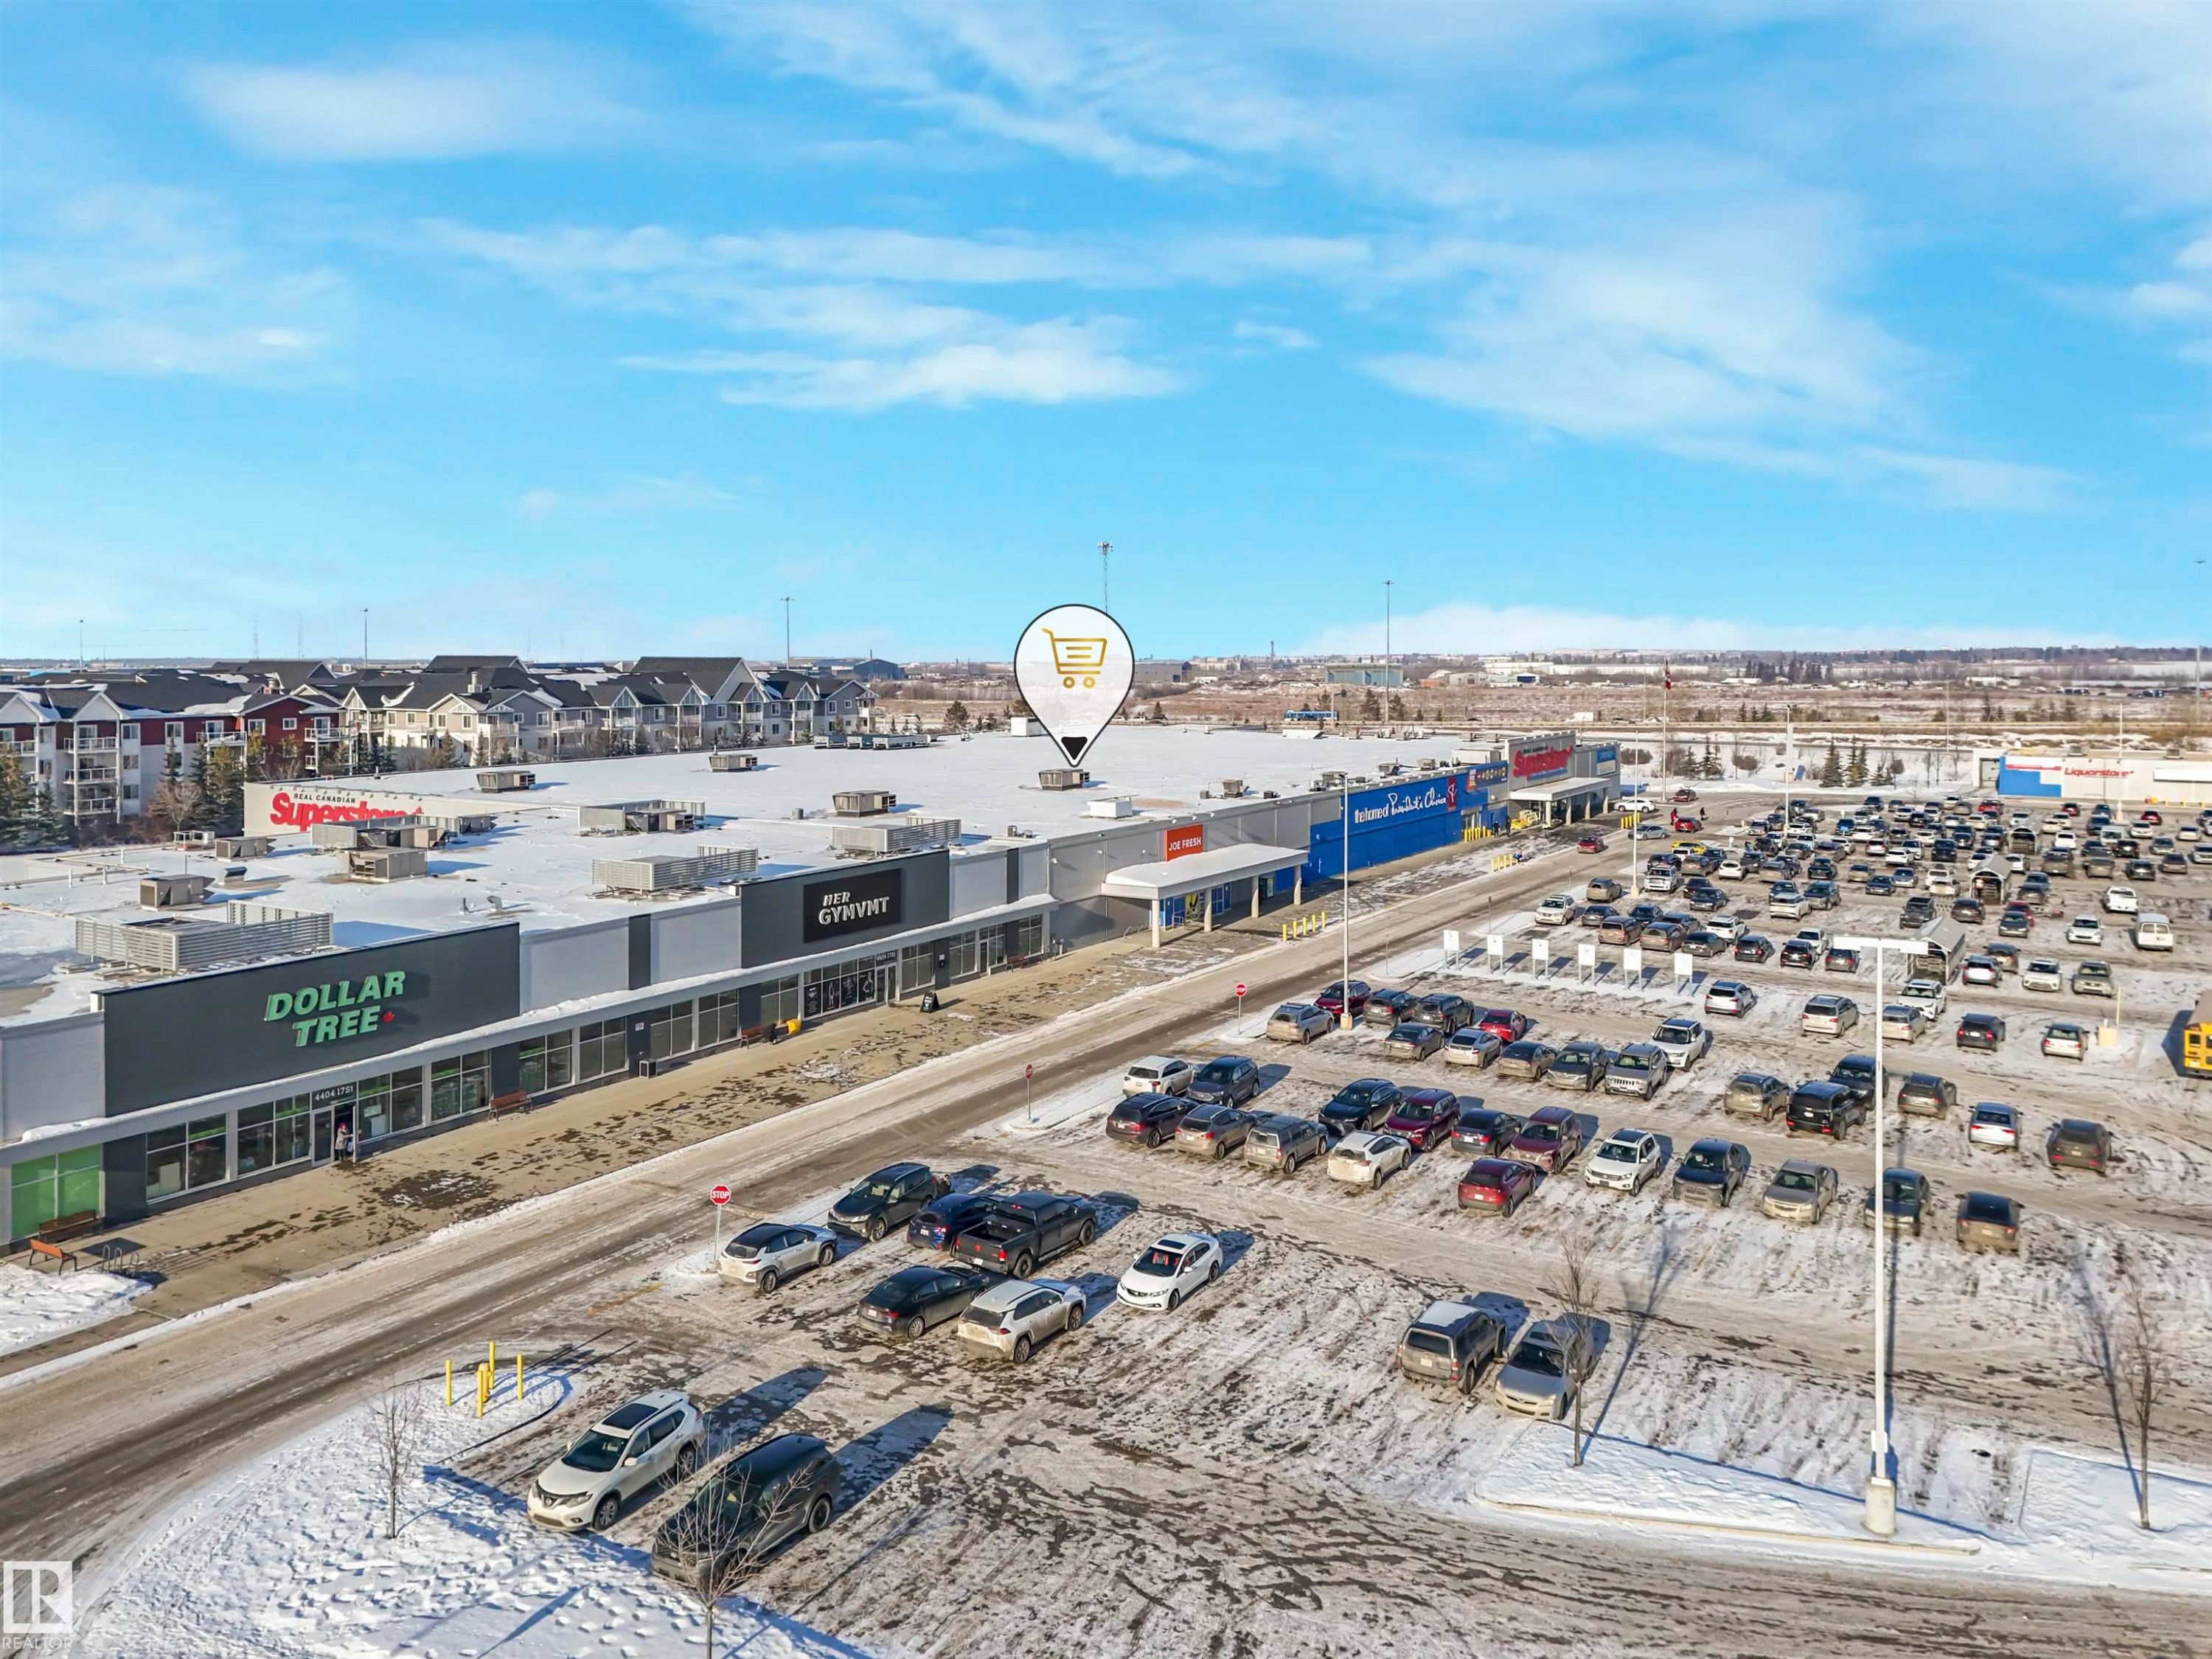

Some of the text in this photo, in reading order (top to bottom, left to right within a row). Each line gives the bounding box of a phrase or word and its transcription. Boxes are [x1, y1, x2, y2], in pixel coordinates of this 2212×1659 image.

[293, 793, 356, 804] REAL CANADIAN
[1354, 809, 1365, 824] the
[1365, 807, 1382, 821] home
[1168, 836, 1202, 852] JOE FRESH
[823, 891, 851, 907] HER
[818, 897, 890, 925] GYMVMT
[264, 970, 406, 1022] DOLLAR
[292, 1005, 380, 1047] TREE
[712, 1190, 729, 1199] STOP
